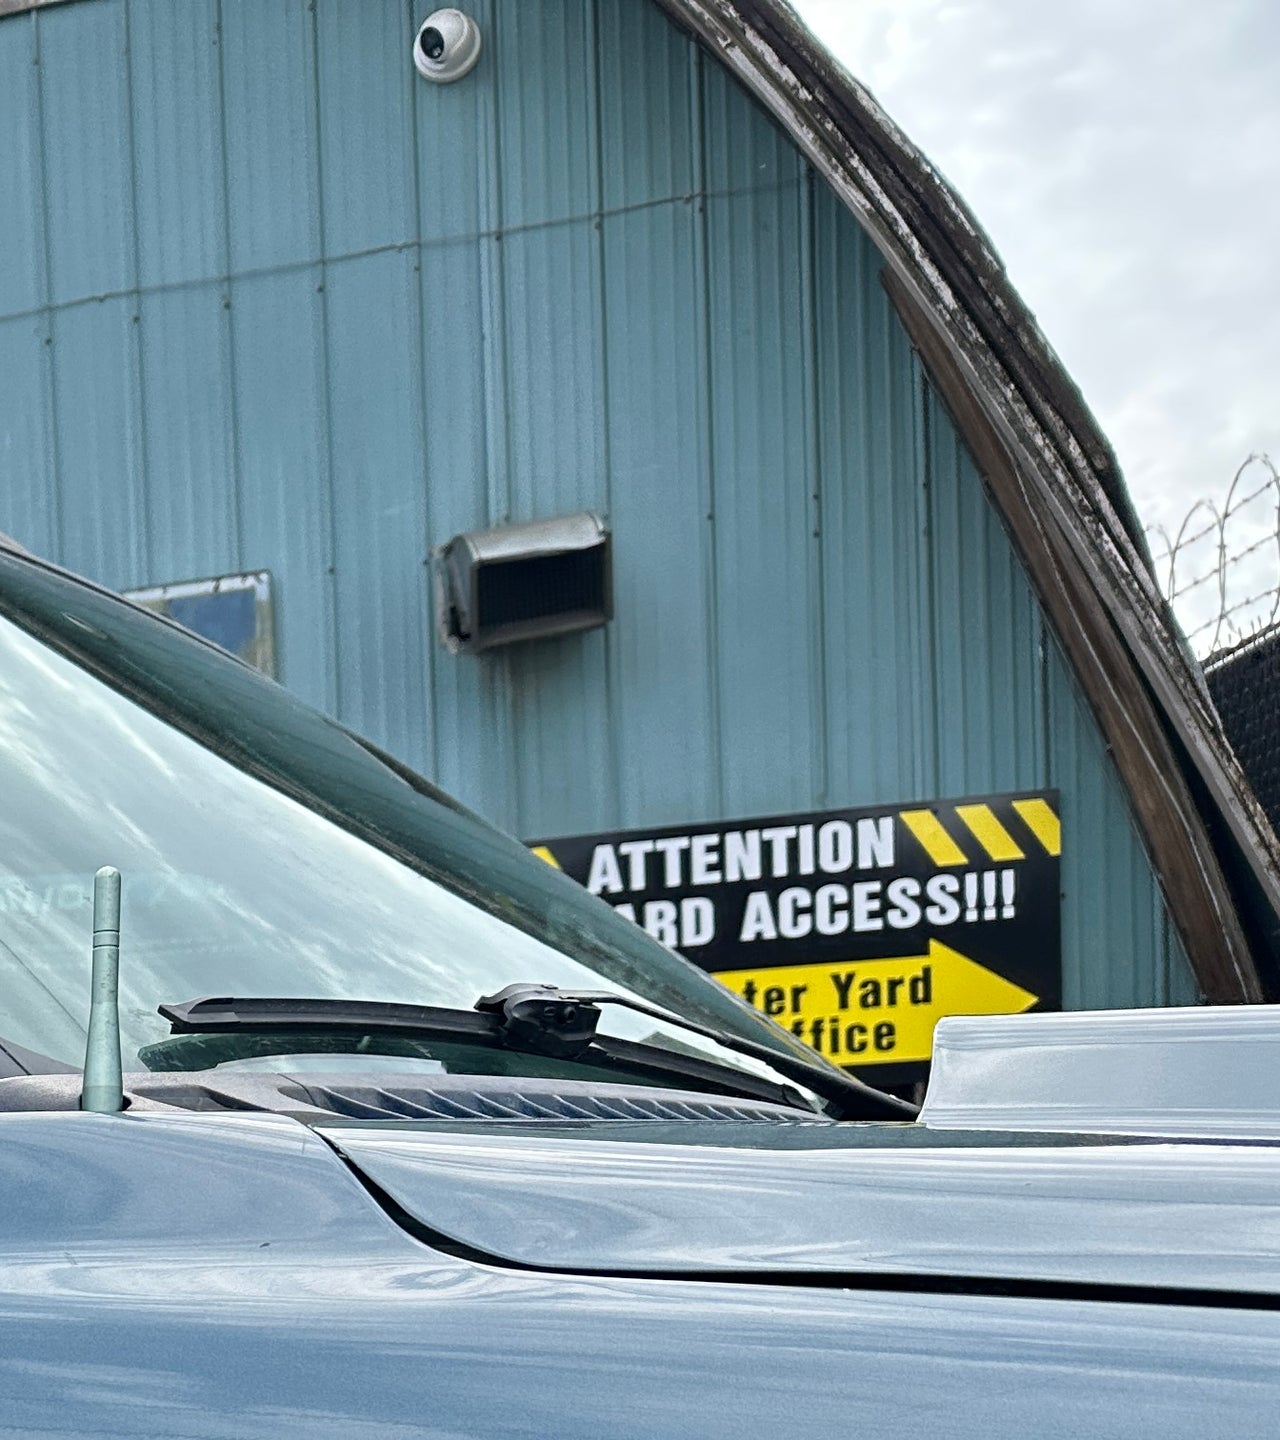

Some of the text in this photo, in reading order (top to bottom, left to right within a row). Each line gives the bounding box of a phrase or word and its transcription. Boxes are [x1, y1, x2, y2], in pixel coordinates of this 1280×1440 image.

[587, 815, 896, 896] ATTENTION
[614, 868, 1016, 949] RD ACCESS!!!
[742, 964, 932, 1016] ter Yard
